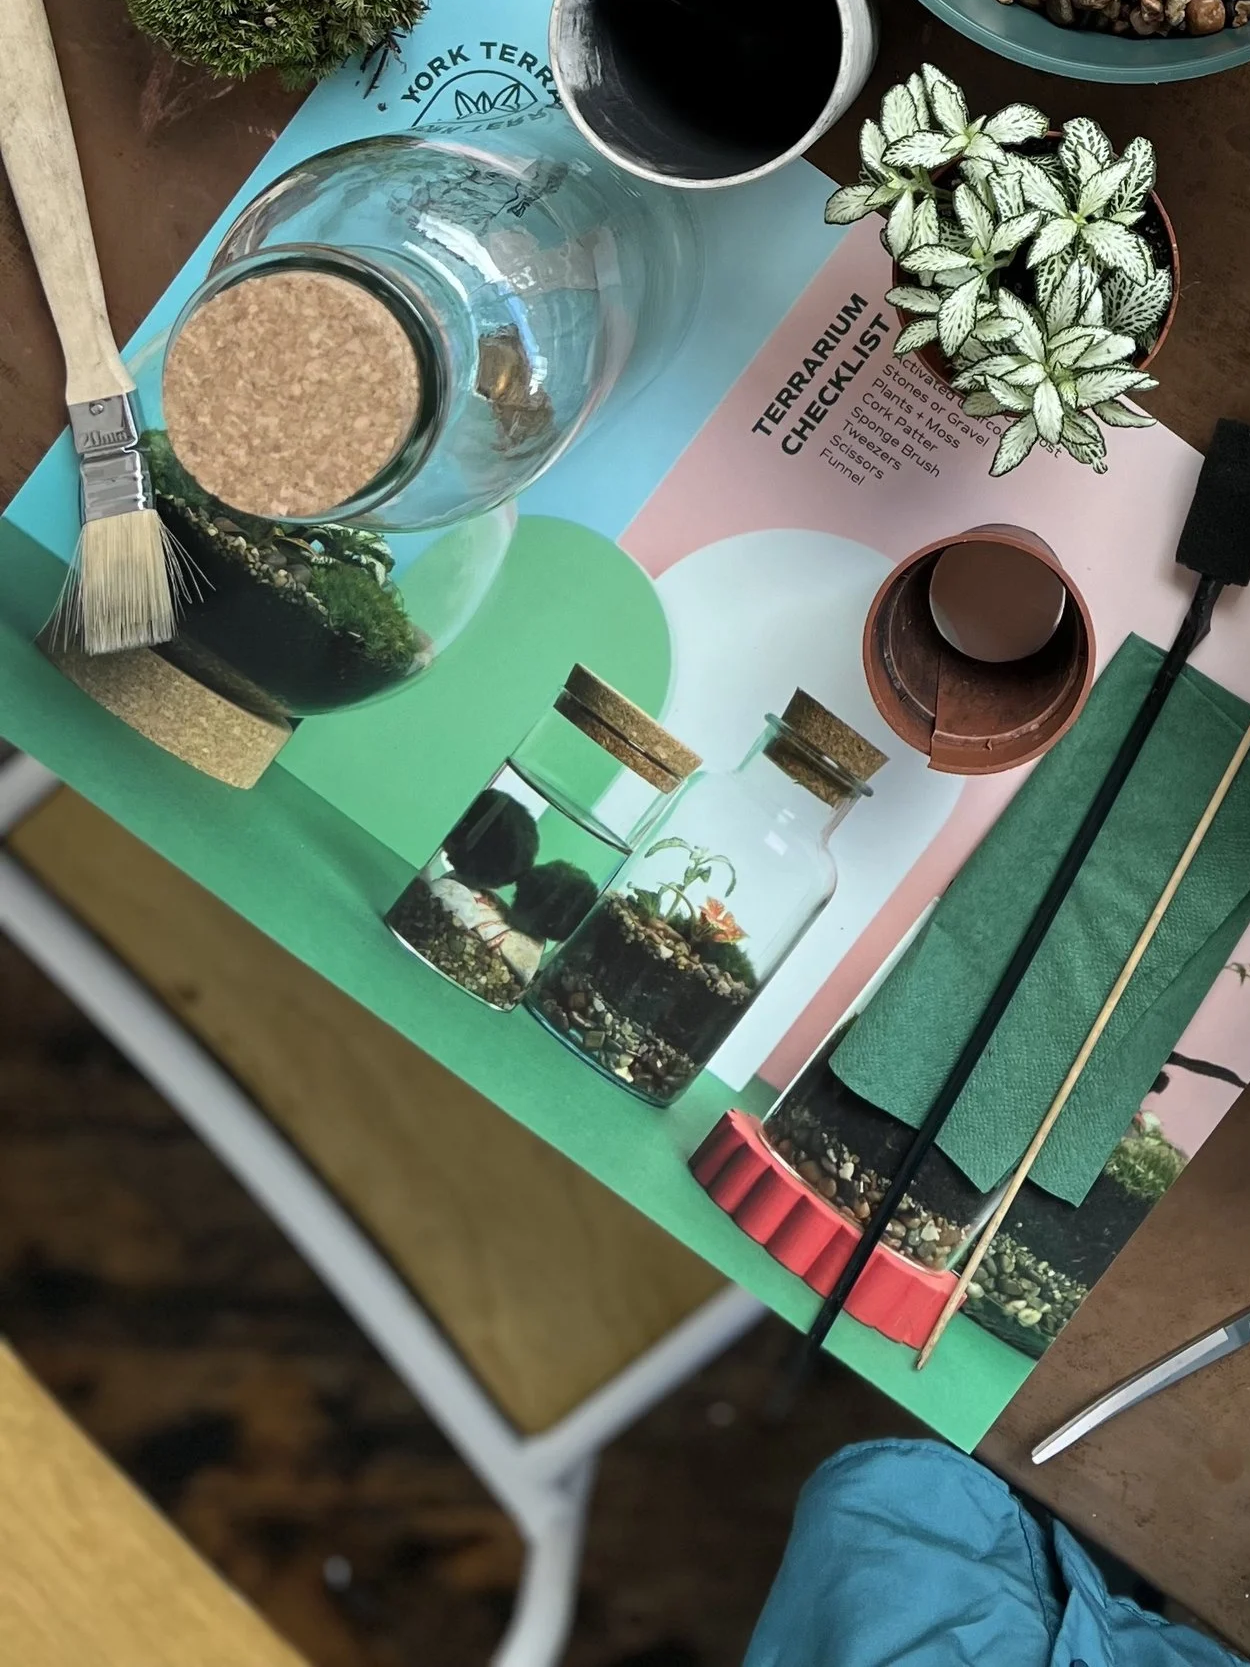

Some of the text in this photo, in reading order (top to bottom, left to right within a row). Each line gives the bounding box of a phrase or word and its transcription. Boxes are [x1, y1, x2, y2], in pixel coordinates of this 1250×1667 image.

[401, 44, 472, 104] YORK
[751, 292, 869, 439] TERRARIUM
[781, 312, 892, 456] CHECKLIST
[862, 392, 938, 452] Cork Patter
[872, 377, 914, 414] Plants
[925, 417, 961, 449] Moss
[882, 364, 990, 447] Stones or Gravel
[819, 447, 866, 486] Funnel
[829, 434, 885, 480] Scissors
[842, 419, 902, 471] Tweezers
[851, 406, 941, 478] Sponge Brush
